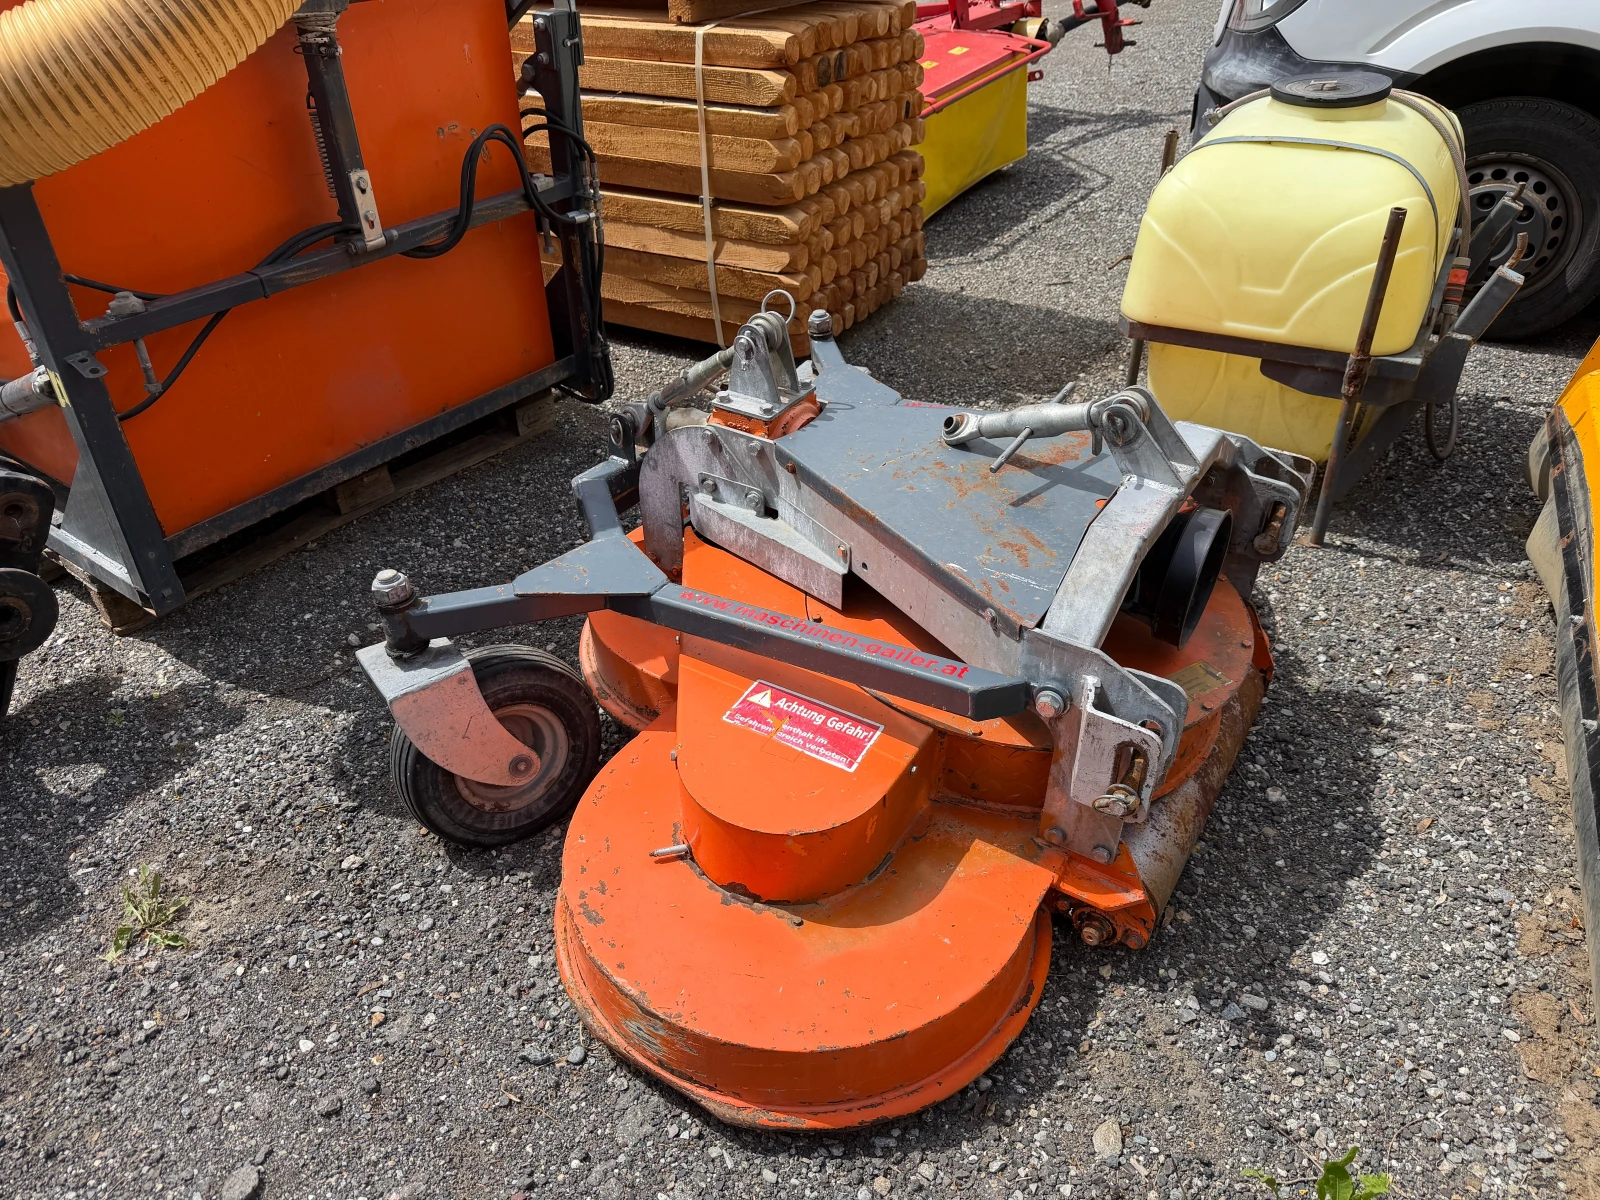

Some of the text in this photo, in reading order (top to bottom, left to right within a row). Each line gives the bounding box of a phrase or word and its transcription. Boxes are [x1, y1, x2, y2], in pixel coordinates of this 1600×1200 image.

[679, 589, 970, 679] www.maschinen-gailer.at
[775, 697, 875, 742] Achtung Gefahr!
[806, 742, 851, 764] verboten!
[815, 736, 828, 745] im
